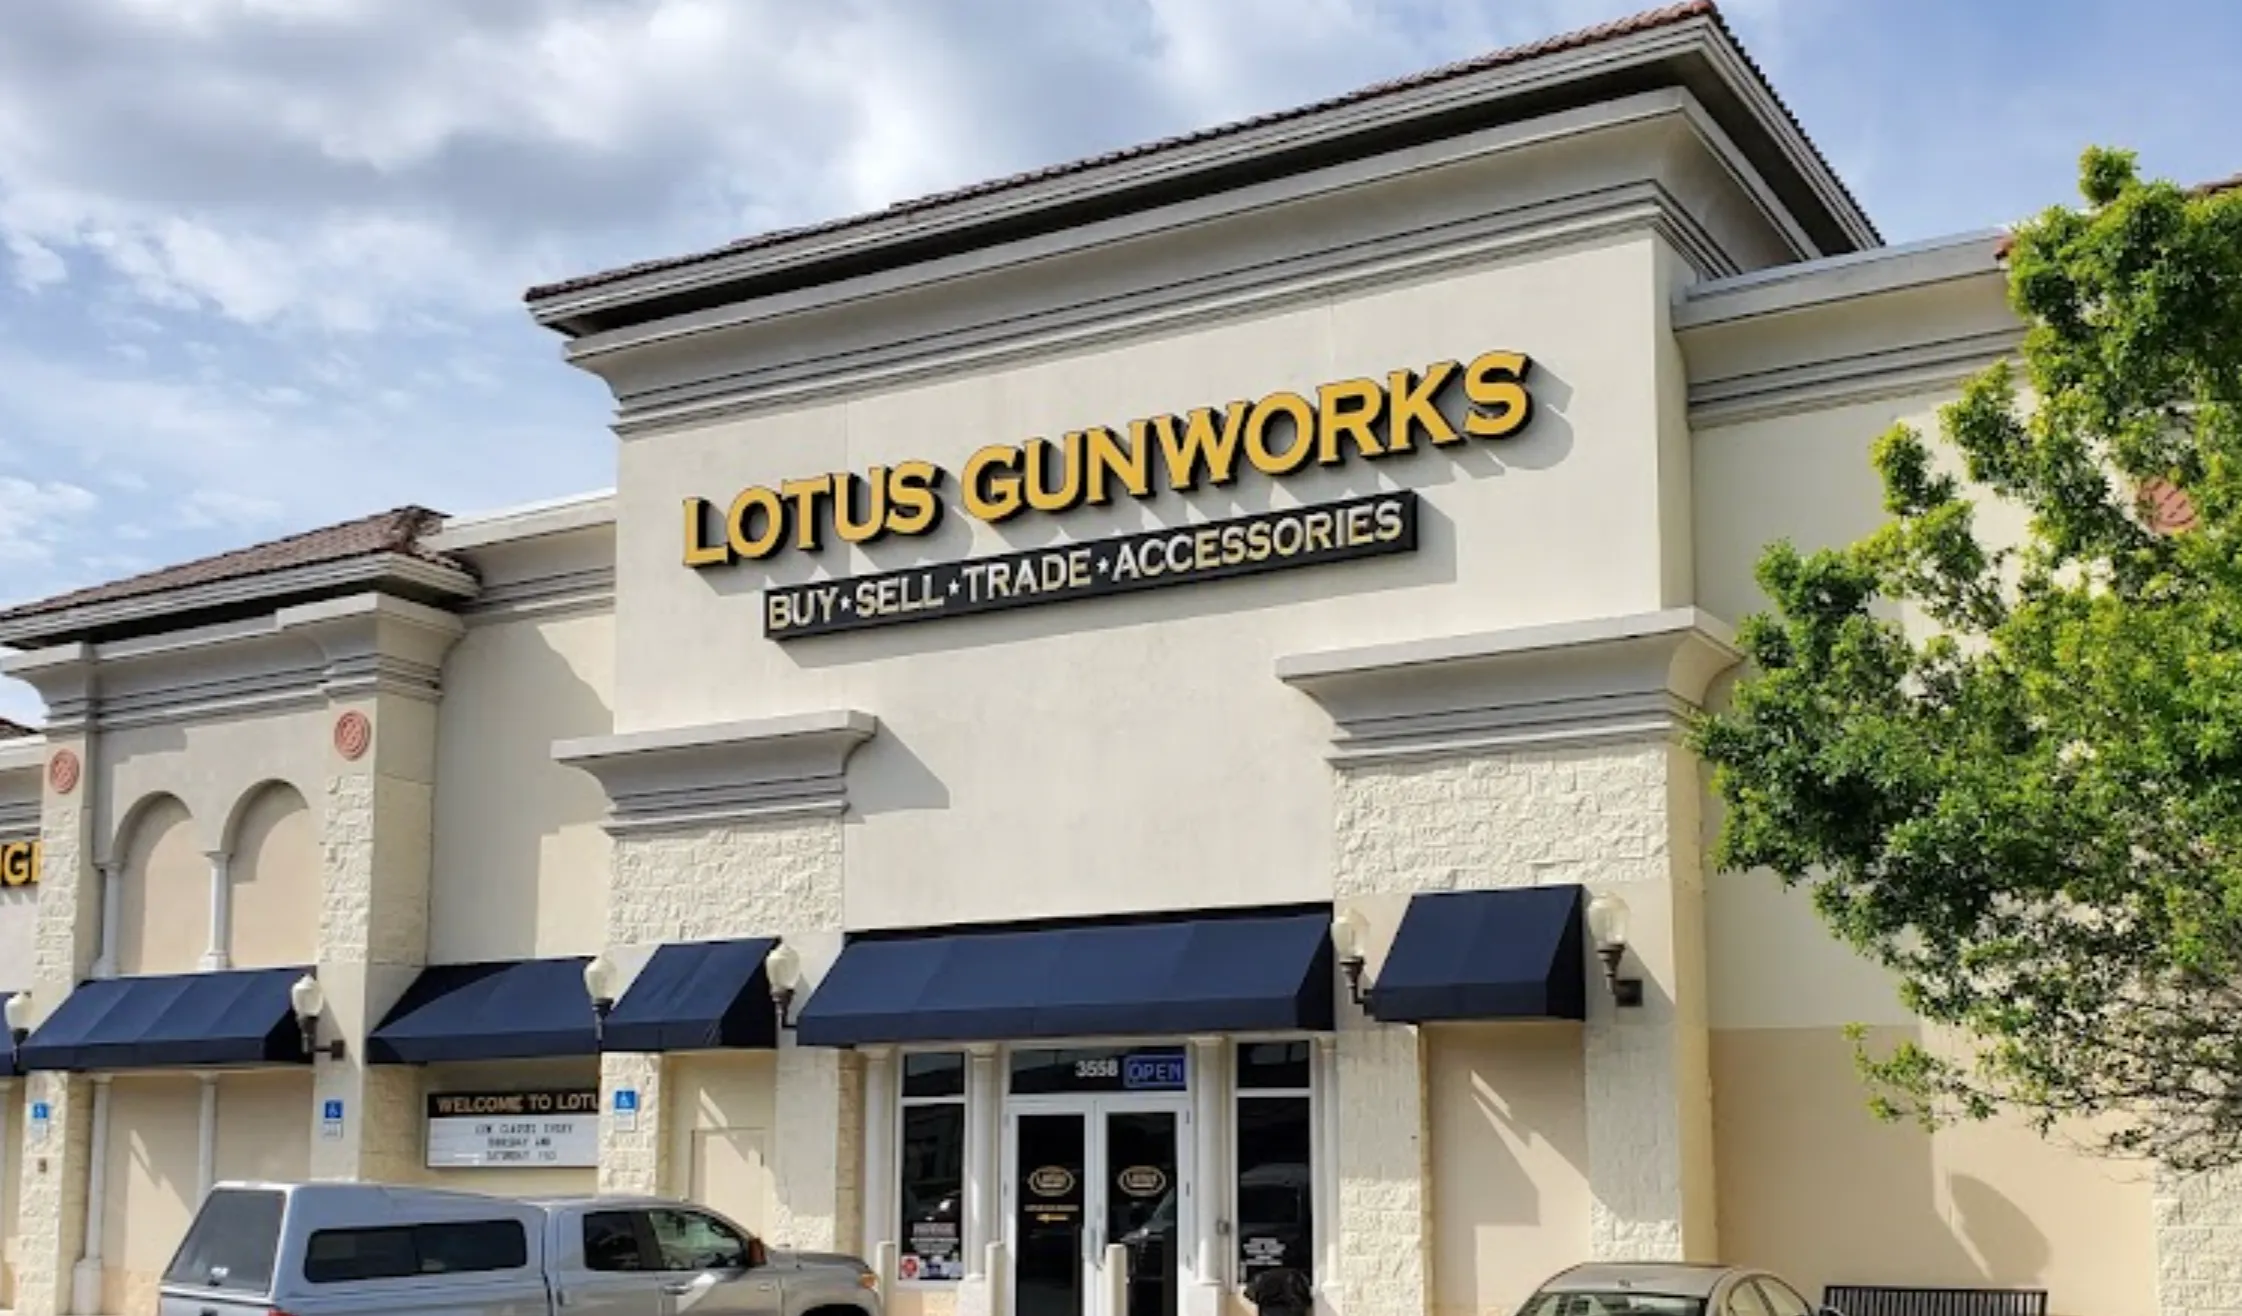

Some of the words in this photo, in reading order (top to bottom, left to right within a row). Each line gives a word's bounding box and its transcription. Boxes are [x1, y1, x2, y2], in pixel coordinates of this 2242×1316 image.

[682, 459, 942, 567] LOTUS
[960, 349, 1531, 523] GUNWORKS
[767, 586, 841, 630] BUY
[854, 573, 945, 619] SELL
[961, 549, 1093, 602] TRADE
[1111, 500, 1403, 583] ACCESSORIES
[1075, 1059, 1119, 1078] 3558
[1128, 1062, 1182, 1081] OPEN
[436, 1096, 524, 1113] WELCOME
[530, 1094, 550, 1110] TO
